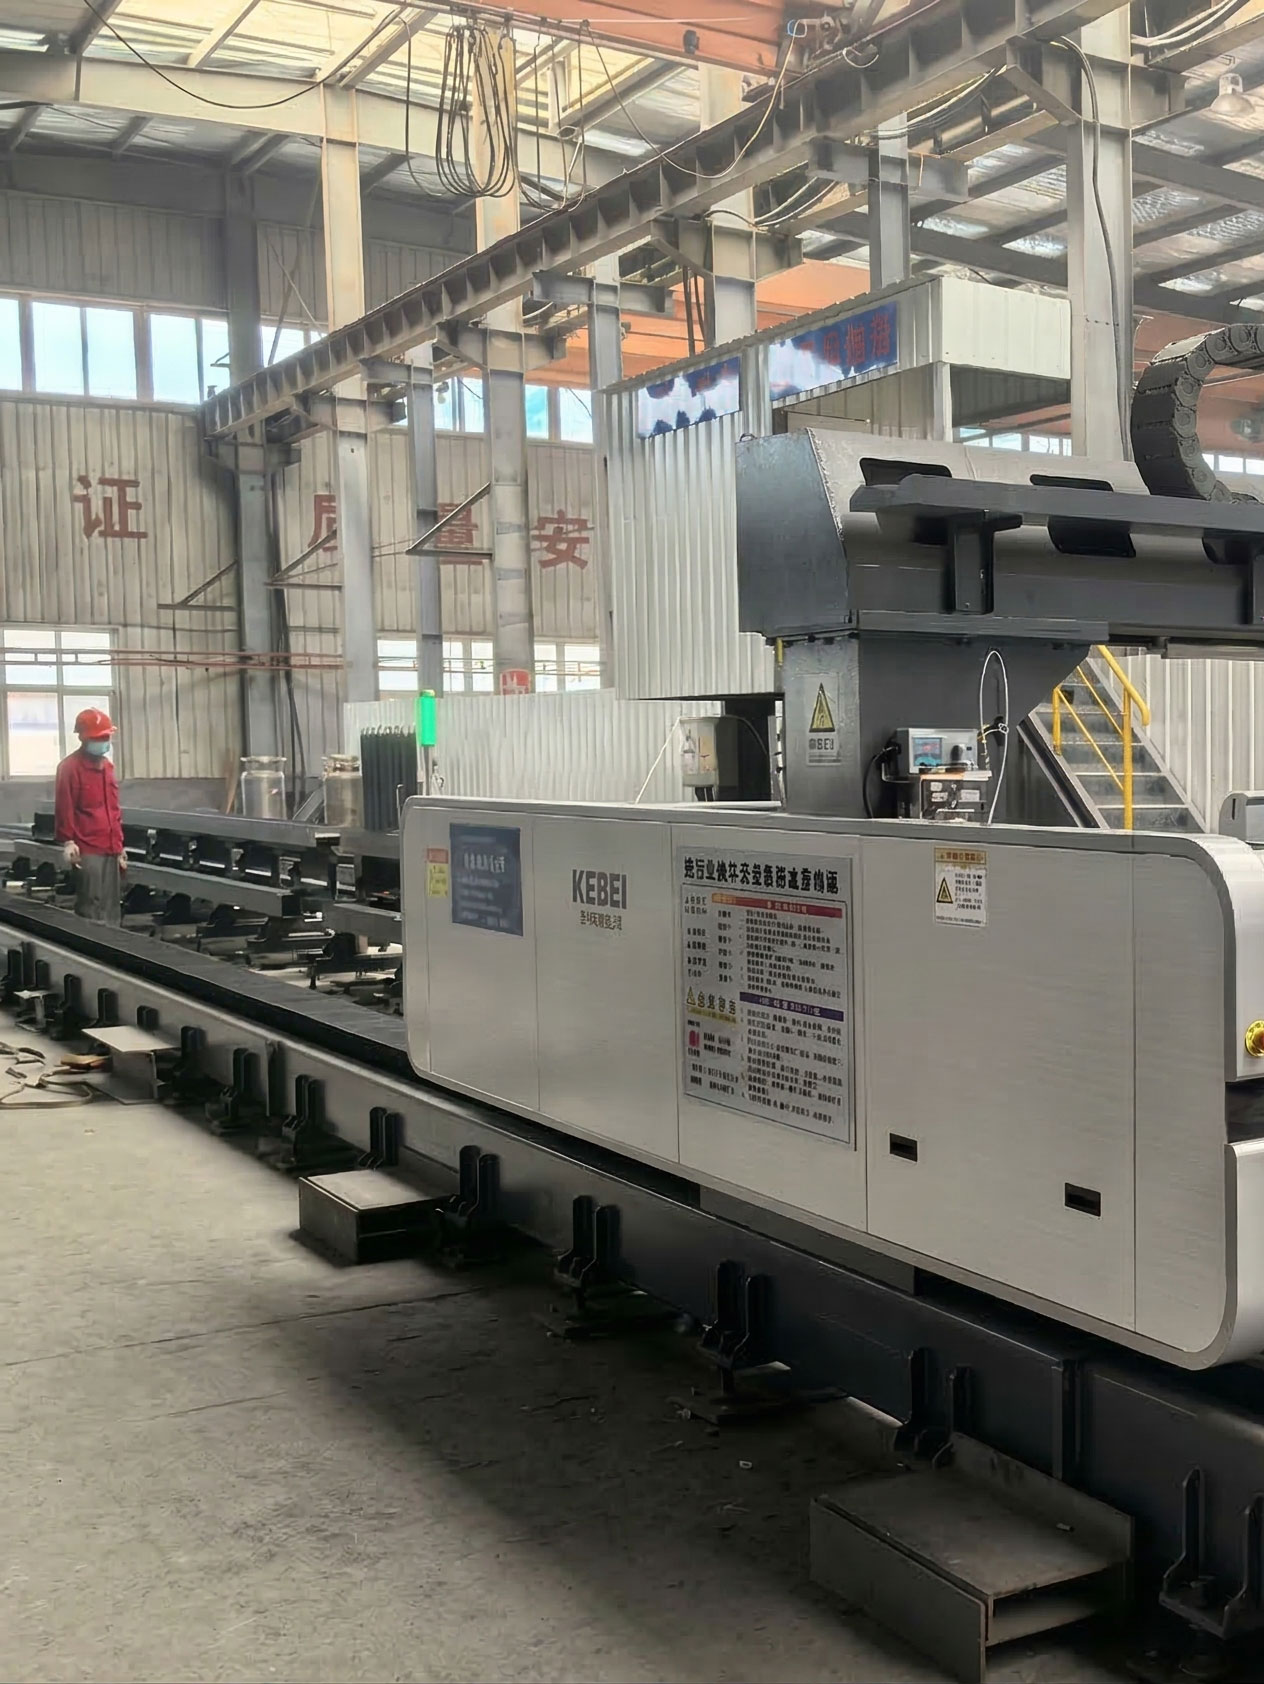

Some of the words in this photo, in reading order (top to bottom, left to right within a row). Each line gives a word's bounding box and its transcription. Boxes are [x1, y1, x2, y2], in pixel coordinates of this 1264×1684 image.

[72, 475, 149, 540] 证
[531, 509, 591, 570] 安
[572, 868, 627, 910] KEBEI
